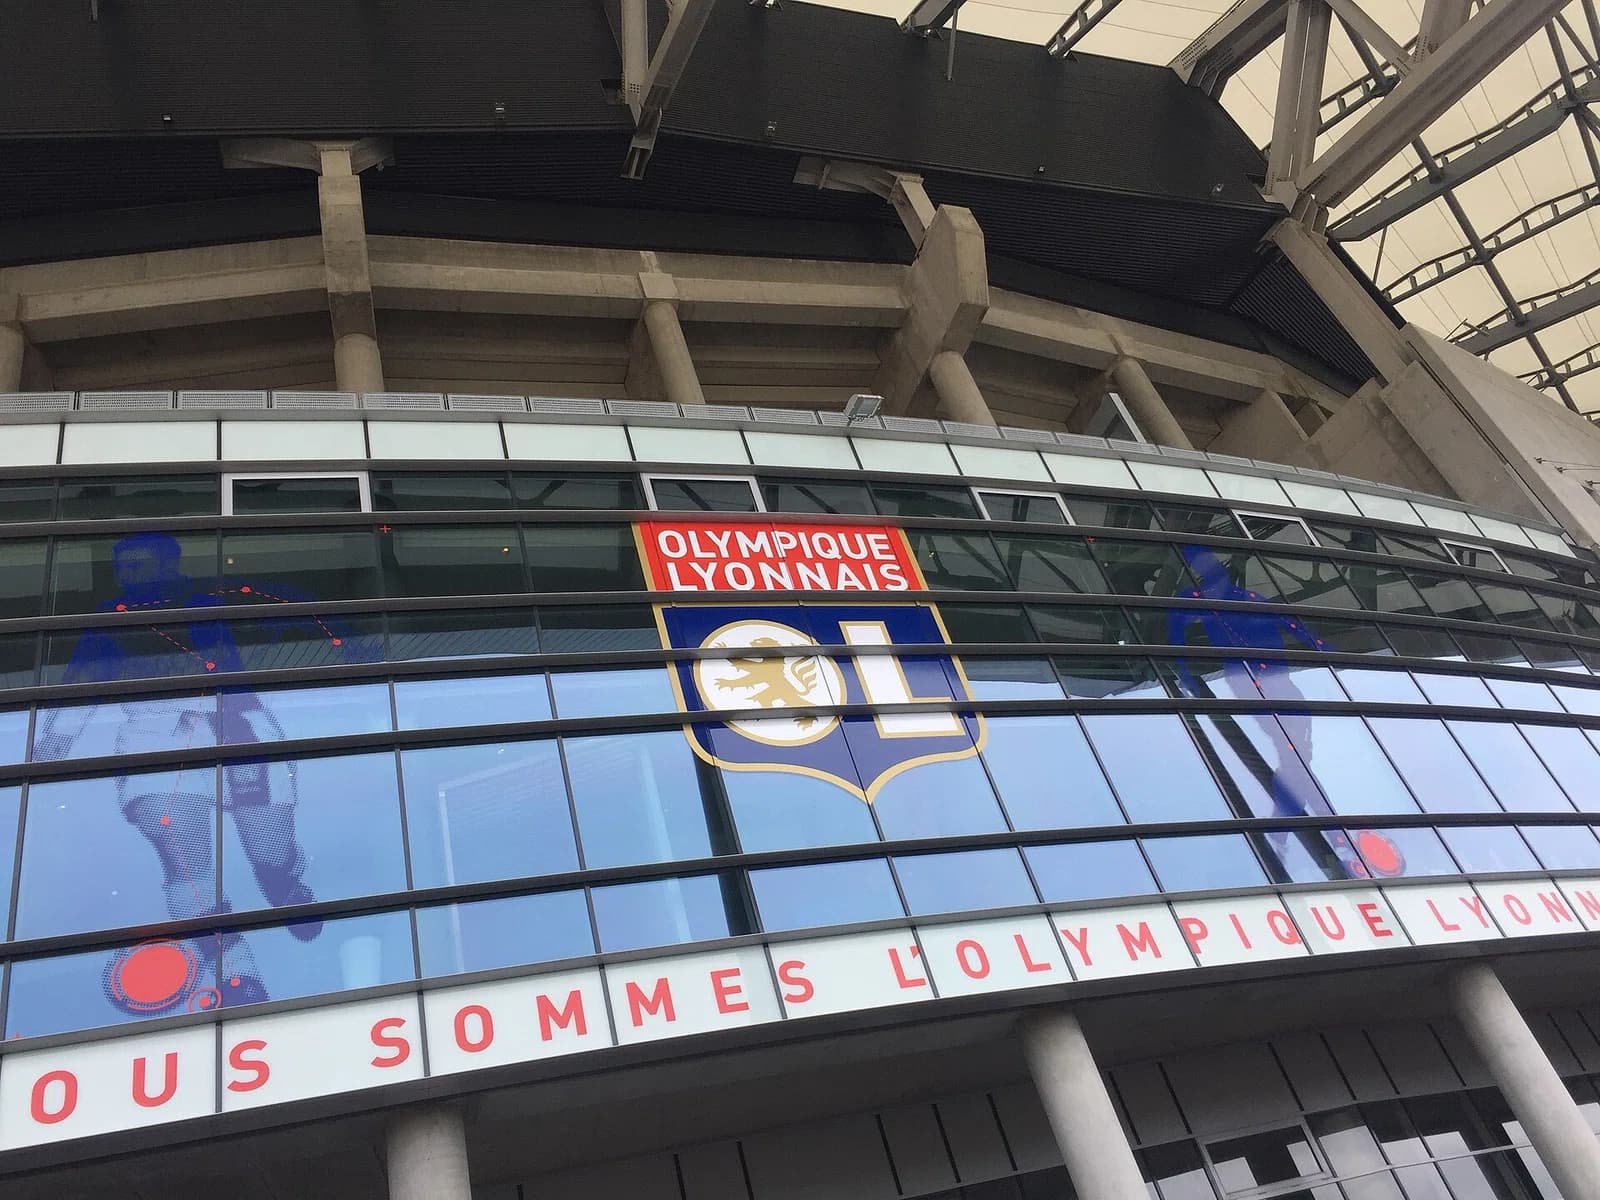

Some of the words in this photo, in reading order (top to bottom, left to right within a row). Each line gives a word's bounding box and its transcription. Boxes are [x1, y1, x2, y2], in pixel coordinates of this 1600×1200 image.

[657, 530, 897, 561] OLYMPIQUE
[666, 561, 910, 592] LYONNAIS
[30, 1040, 271, 1125] OUS
[370, 960, 815, 1068] SOMMES
